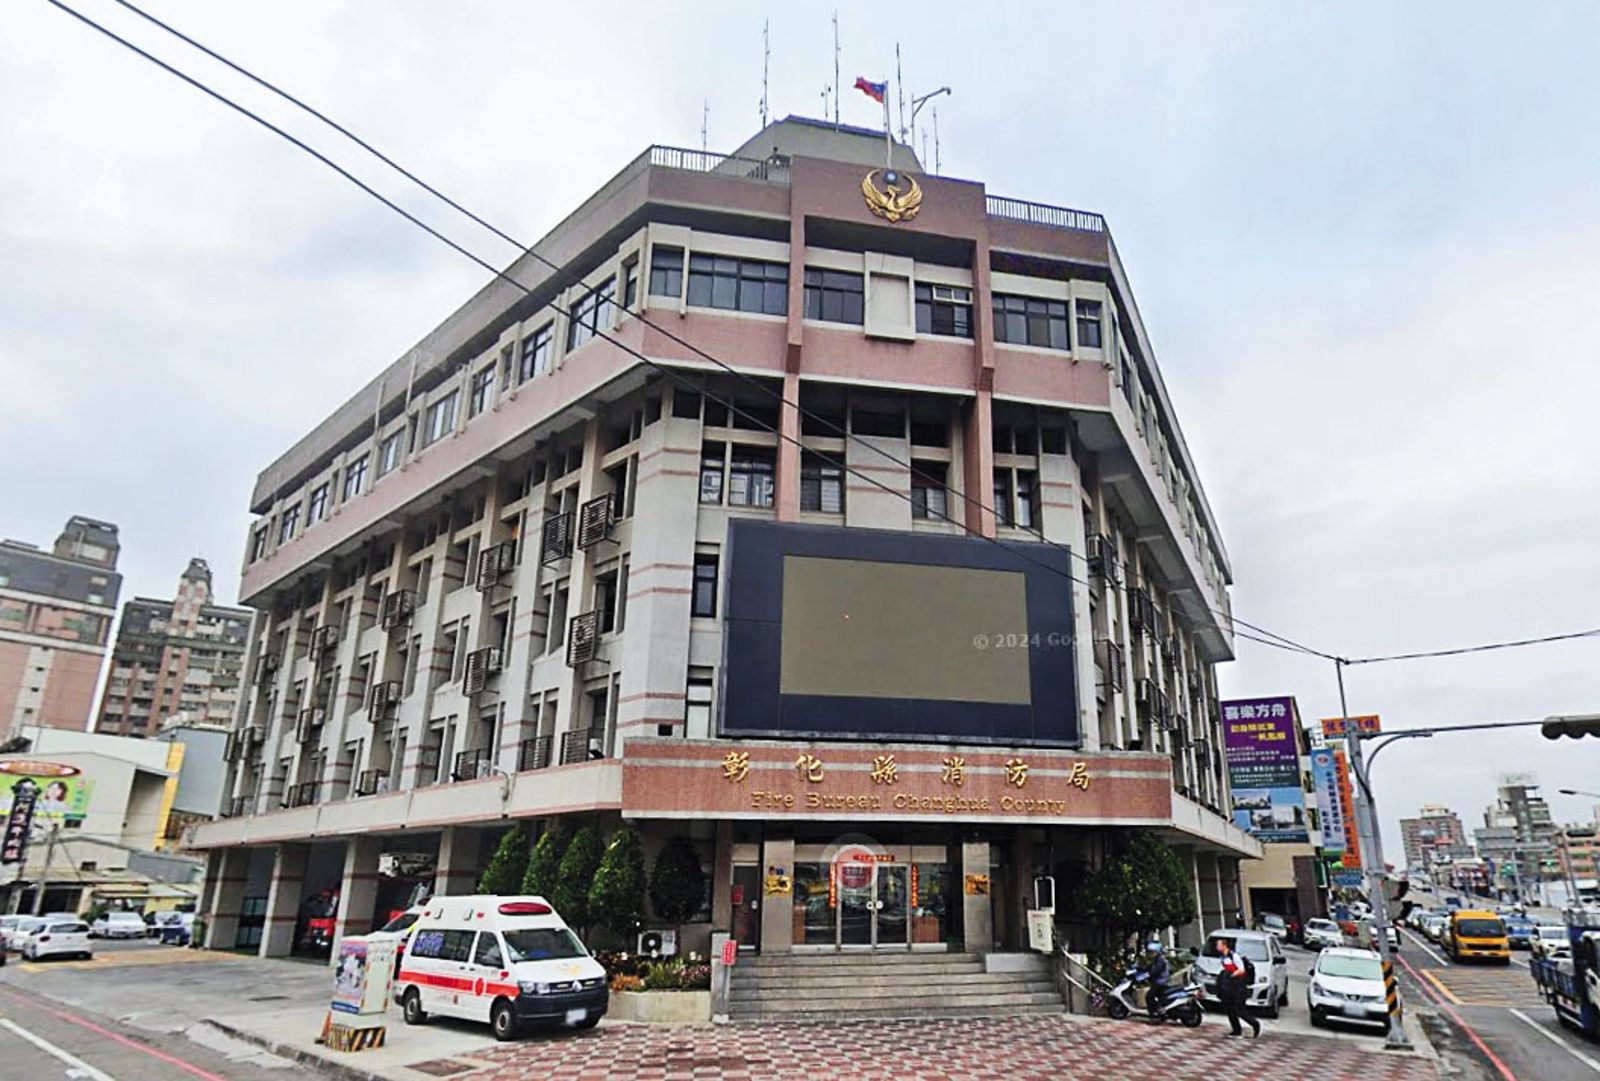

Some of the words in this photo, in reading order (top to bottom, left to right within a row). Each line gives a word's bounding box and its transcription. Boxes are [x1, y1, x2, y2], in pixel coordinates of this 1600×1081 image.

[721, 751, 1091, 792] 彰化縣消防局
[751, 791, 795, 808] Fire
[805, 792, 882, 810] Bureau
[893, 793, 991, 813] Changhua
[1000, 795, 1066, 815] County
